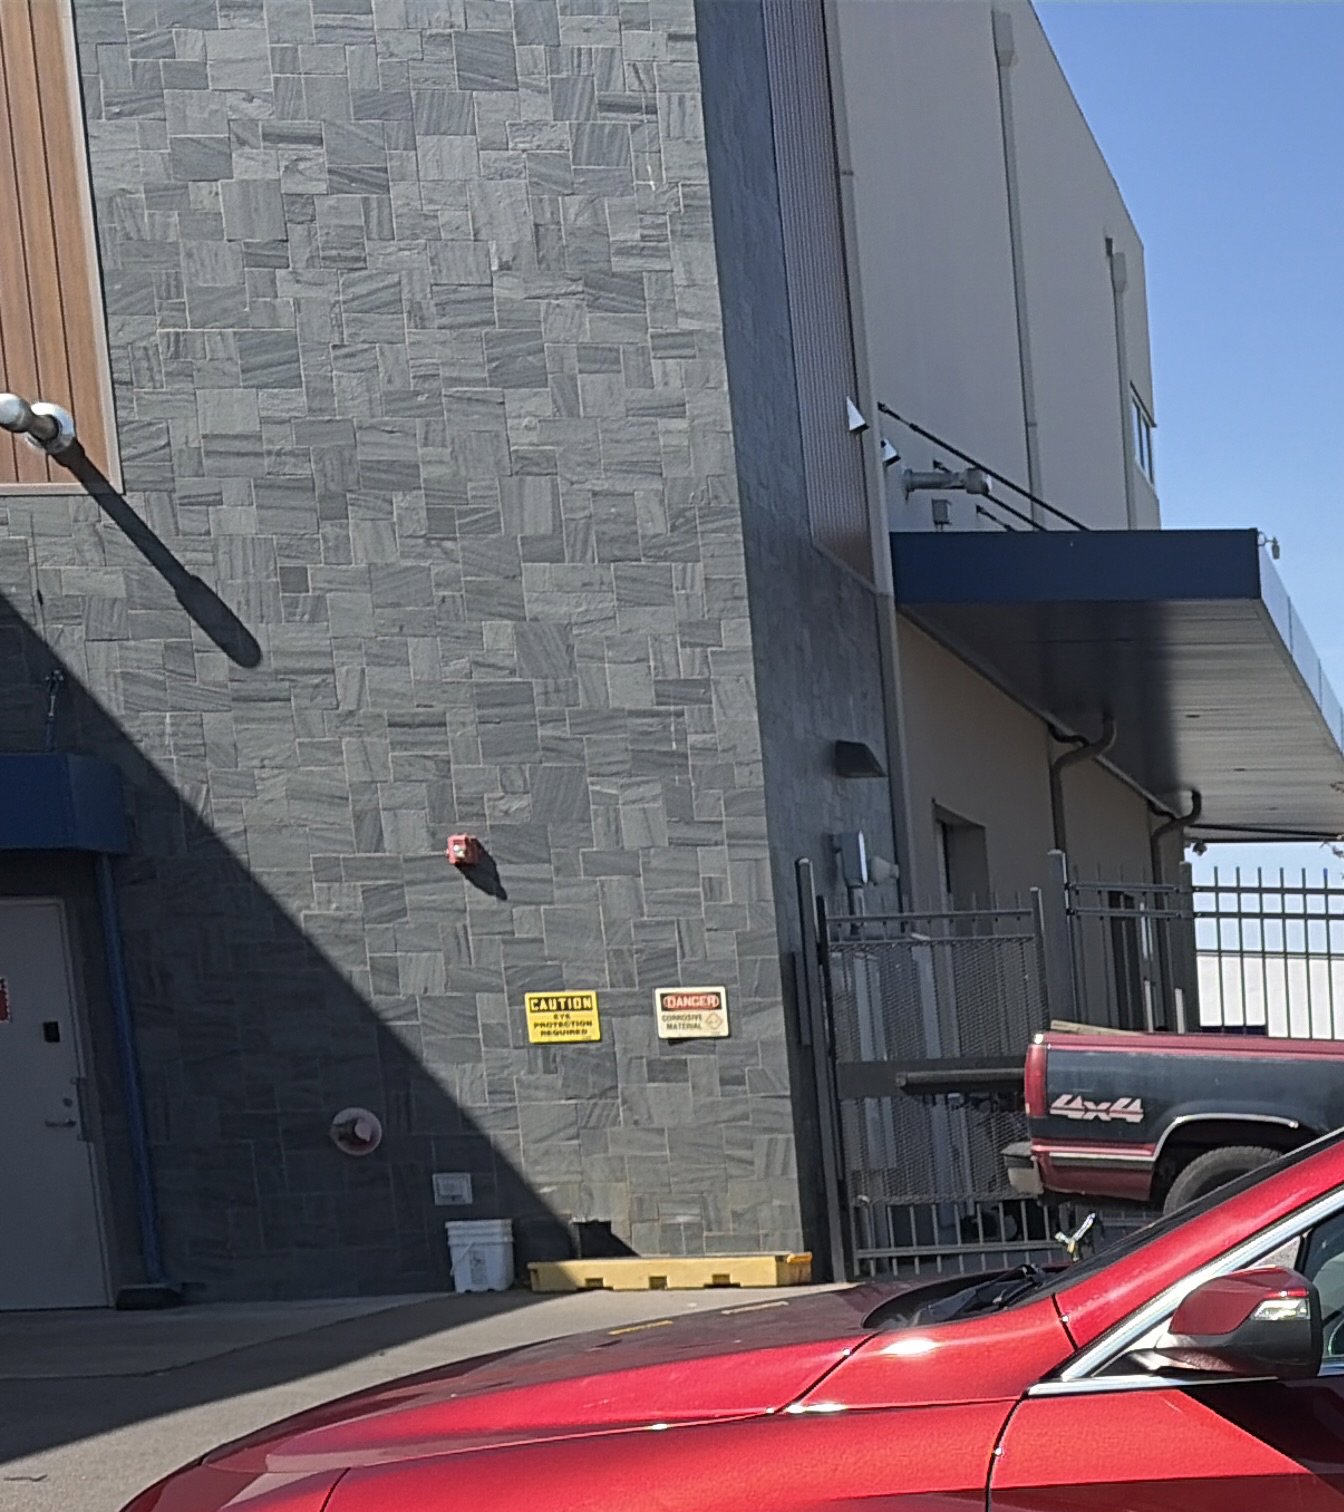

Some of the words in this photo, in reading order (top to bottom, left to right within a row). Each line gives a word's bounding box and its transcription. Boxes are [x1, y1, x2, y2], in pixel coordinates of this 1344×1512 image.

[530, 997, 592, 1011] CAUTION
[667, 994, 717, 1009] DANGER
[662, 1013, 703, 1022] CORROSIVE
[533, 1020, 593, 1029] PROTECTION
[666, 1022, 703, 1030] MATERIAL
[540, 1029, 588, 1037] REQUIRED
